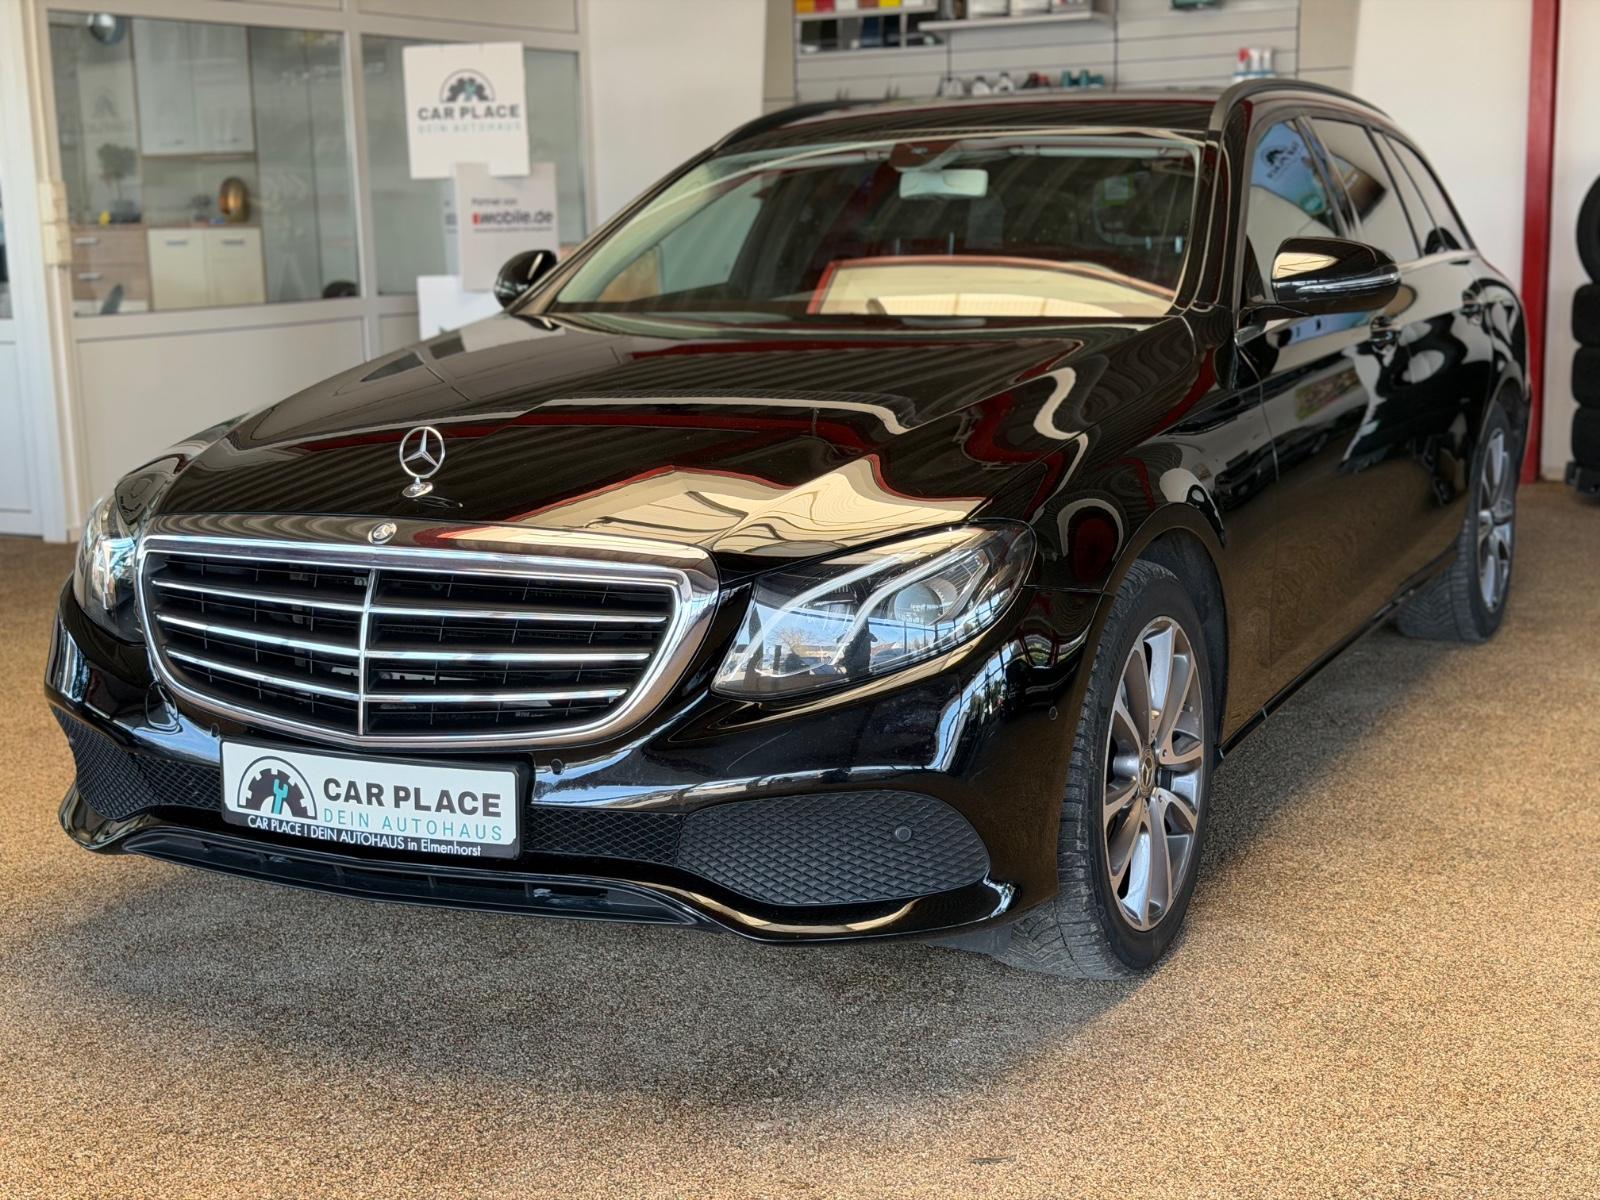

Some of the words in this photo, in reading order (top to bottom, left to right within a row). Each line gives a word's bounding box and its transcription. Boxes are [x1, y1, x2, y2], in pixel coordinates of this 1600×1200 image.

[417, 106, 454, 121] CAR
[460, 103, 520, 119] PLACE
[480, 209, 553, 225] mobile.de
[323, 777, 385, 807] CAR
[393, 785, 502, 818] PLACE
[247, 815, 269, 830] CAR
[270, 819, 302, 836] PLACE
[310, 825, 337, 842] DEIN
[339, 830, 405, 850] AUTOHAUS
[407, 838, 418, 851] in
[421, 839, 482, 857] Elmenhorst
[324, 808, 369, 828] DEIN
[382, 815, 502, 841] AUTOHAUS
